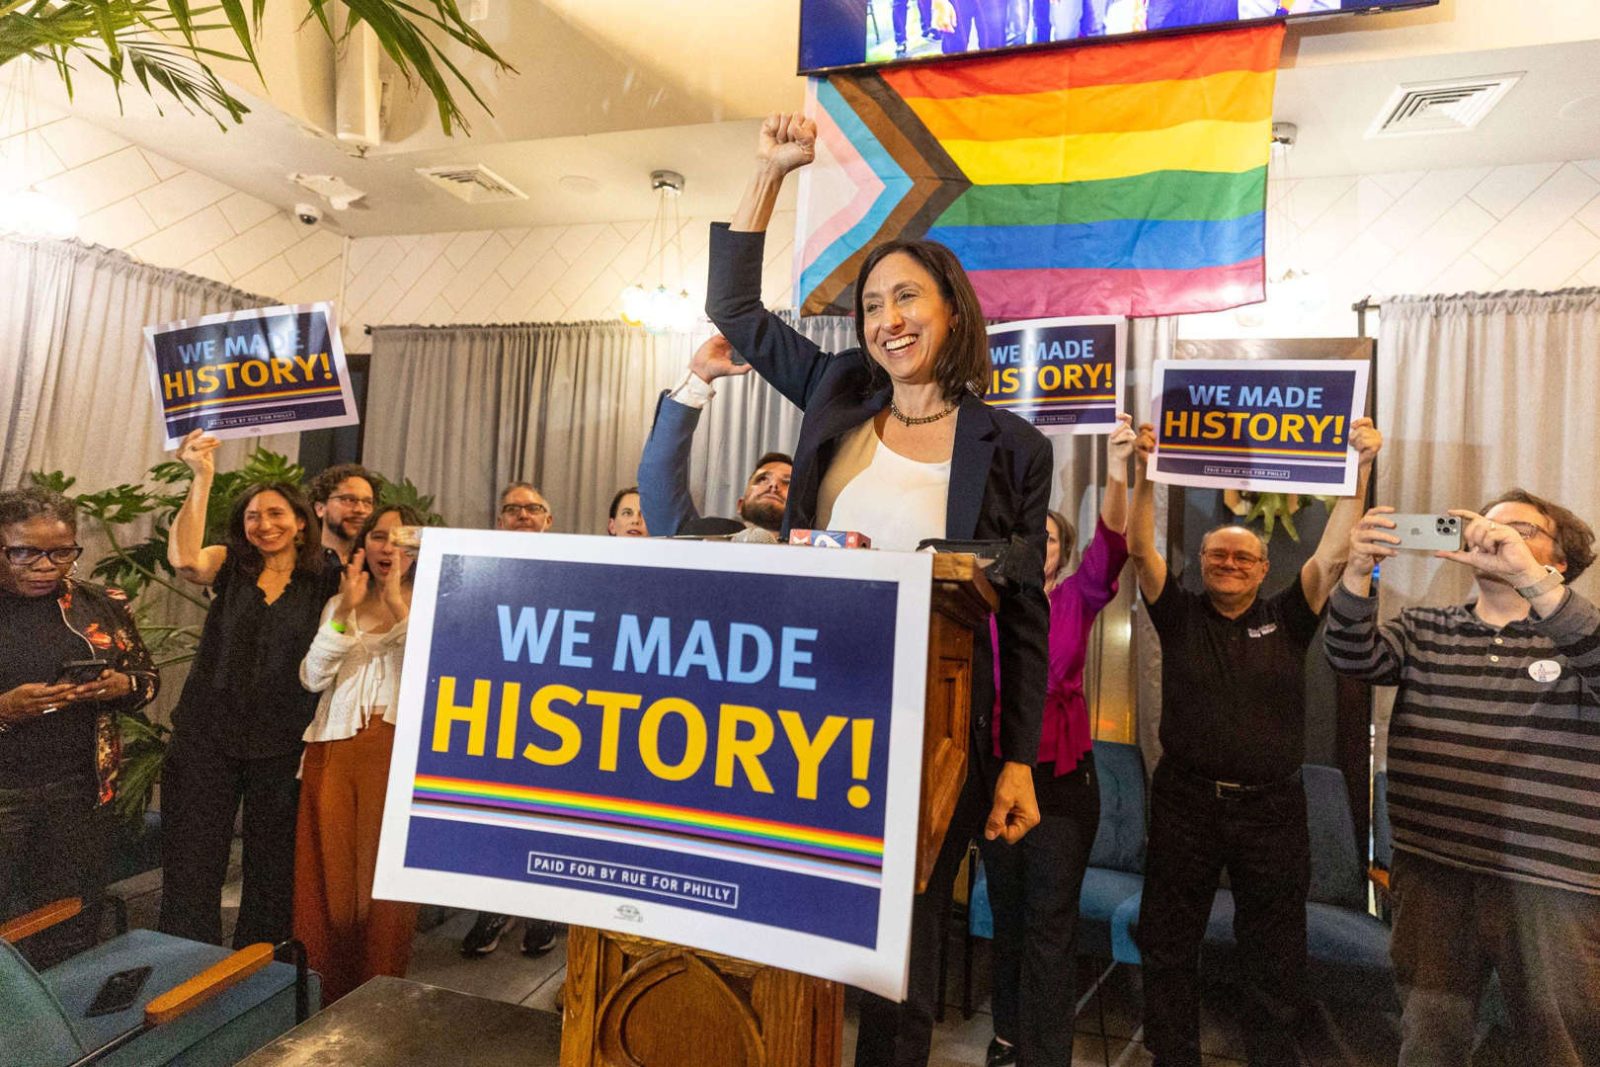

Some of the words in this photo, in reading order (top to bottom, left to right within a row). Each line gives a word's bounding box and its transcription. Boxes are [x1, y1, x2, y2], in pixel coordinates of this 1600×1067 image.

[178, 340, 216, 364] WE
[225, 330, 304, 358] MADE
[990, 344, 1021, 365] WE
[1028, 339, 1094, 360] MADE
[163, 351, 333, 400] HISTORY!
[985, 363, 1112, 395] ISTORY!
[1188, 385, 1231, 406] WE
[1238, 386, 1324, 408] MADE
[1164, 410, 1345, 445] HISTORY!
[497, 604, 596, 669] WE
[612, 613, 819, 690] MADE
[431, 675, 875, 809] HISTORY!
[534, 857, 565, 872] PAID
[569, 864, 596, 877] FOR
[600, 869, 616, 880] BY
[621, 871, 646, 886] RUE
[652, 875, 678, 891] FOR
[683, 882, 730, 901] PHILLY
